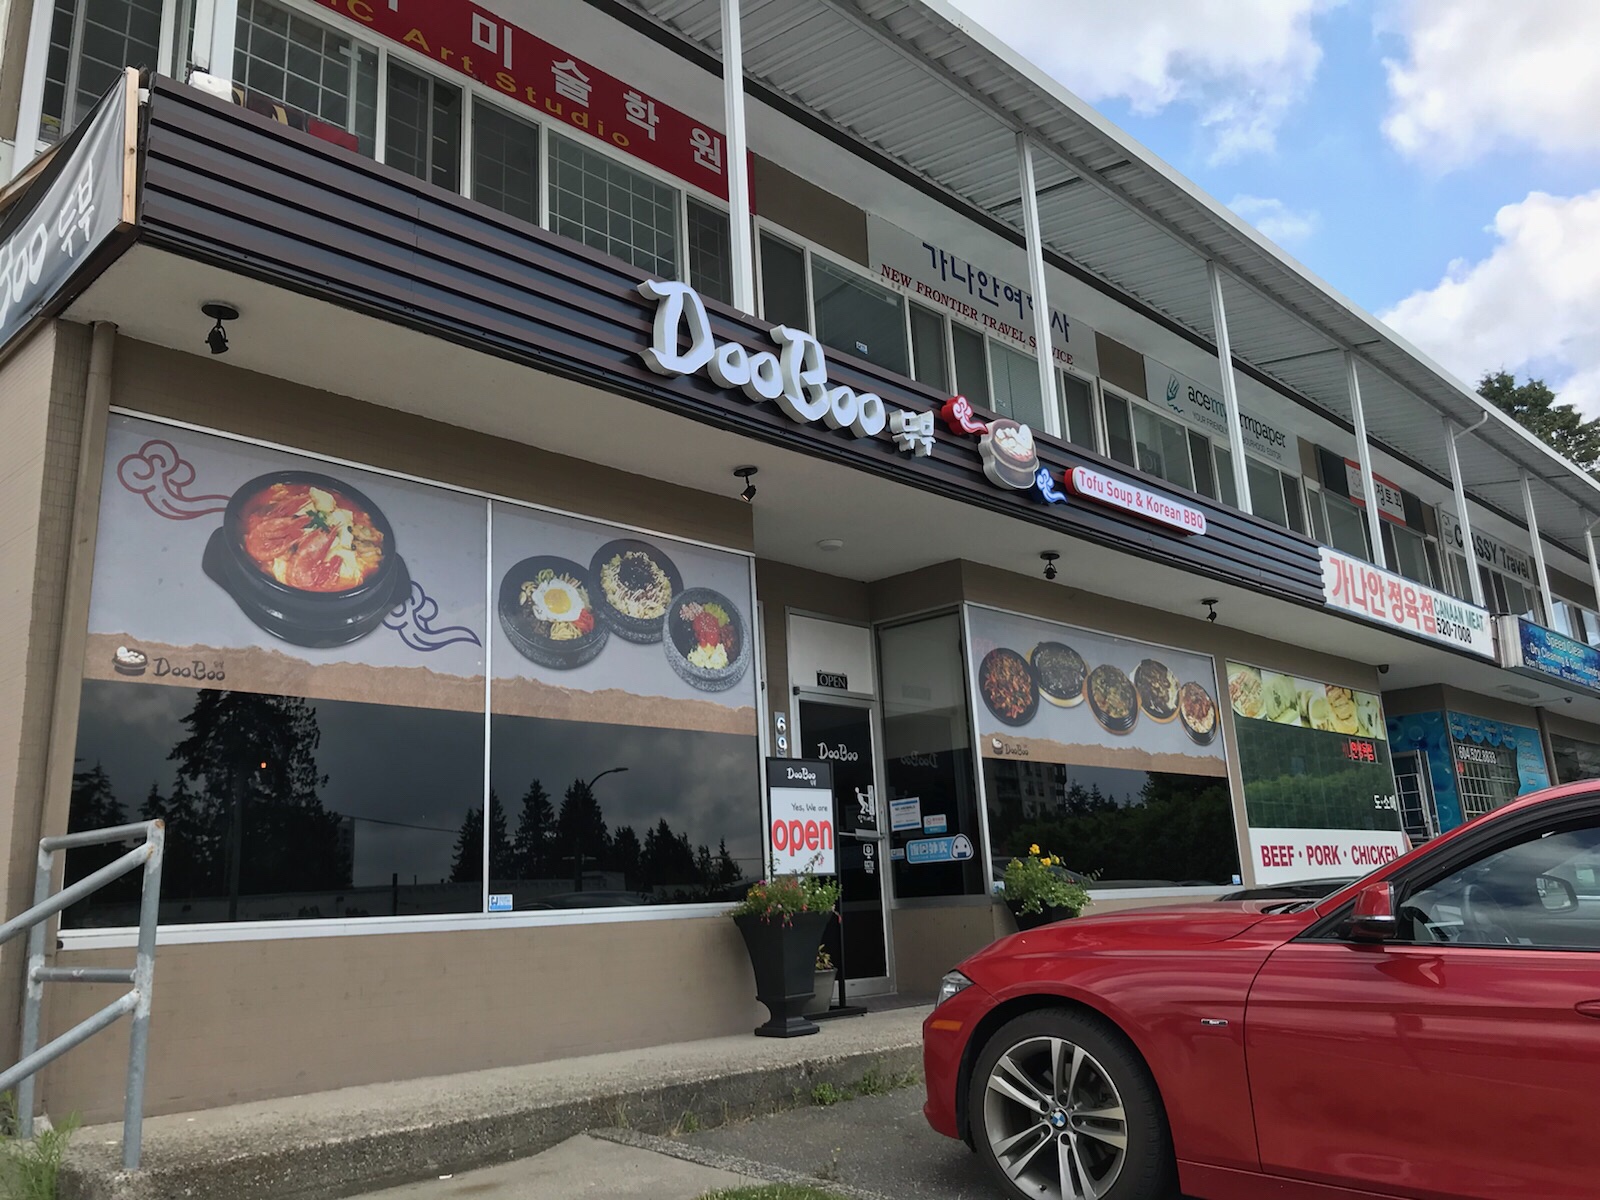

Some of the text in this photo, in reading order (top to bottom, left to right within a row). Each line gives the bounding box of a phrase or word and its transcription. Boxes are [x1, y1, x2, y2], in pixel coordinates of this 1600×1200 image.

[403, 28, 474, 76] Art
[495, 71, 630, 148] Studio
[471, 11, 722, 176] 미술학원
[881, 263, 912, 289] NEW
[916, 280, 979, 321] FRONTIER
[981, 313, 1026, 343] TRAVEL
[1078, 469, 1204, 530] Tofu Soup & Korean BBQ
[1499, 546, 1530, 580] Travel
[1433, 597, 1484, 632] CANAAN MEAT
[1436, 617, 1472, 644] 520-7008
[152, 657, 226, 681] DooBoo
[819, 673, 846, 688] OPEN
[817, 742, 859, 761] DooBoo
[787, 767, 816, 780] DooBoo
[790, 802, 829, 813] Yes, We are
[772, 819, 833, 856] open
[1260, 845, 1295, 867] BEEF
[1305, 845, 1342, 866] PORK
